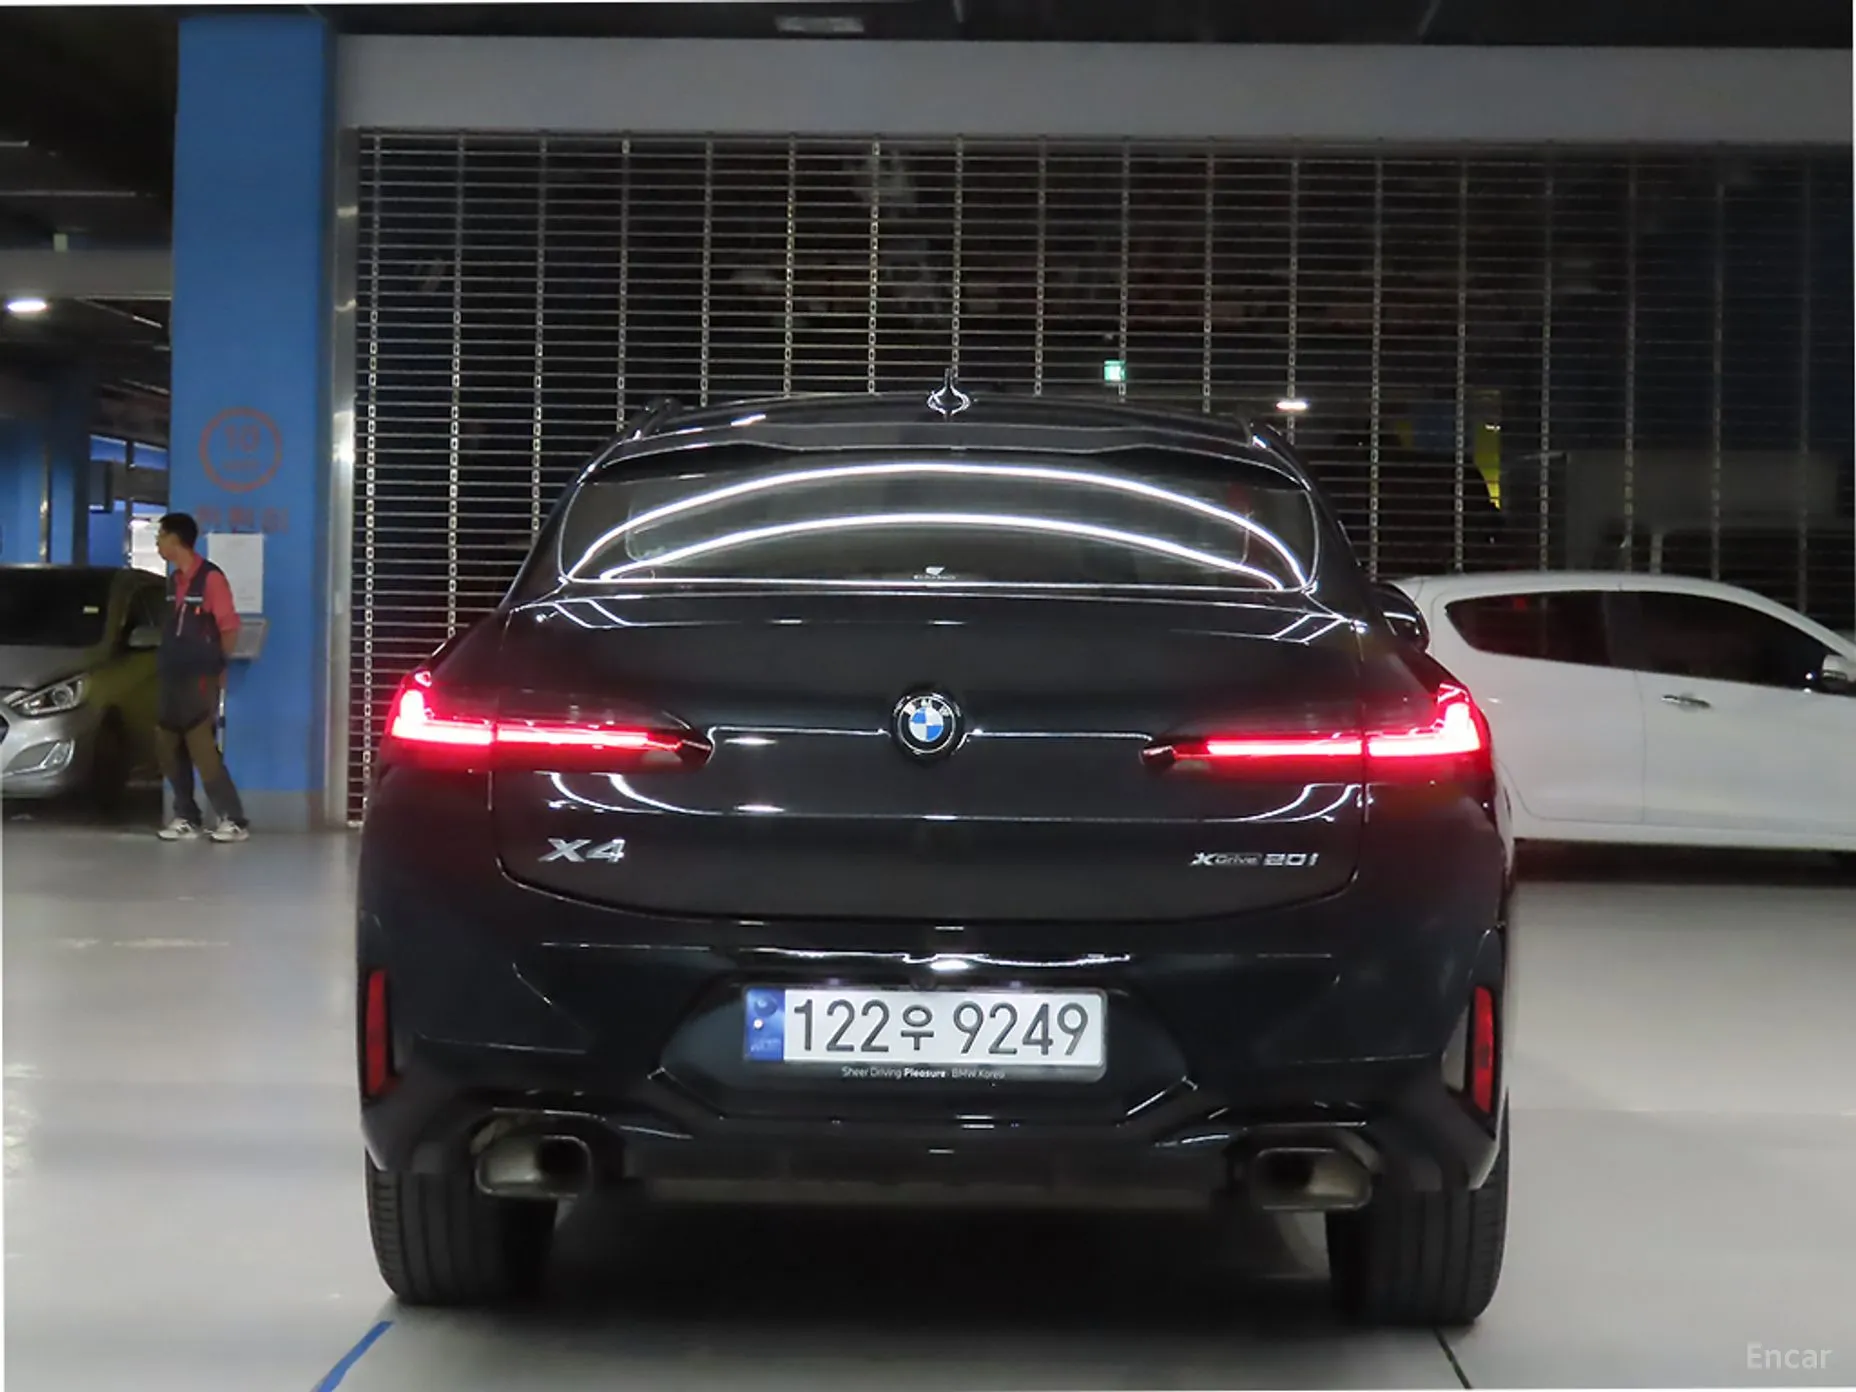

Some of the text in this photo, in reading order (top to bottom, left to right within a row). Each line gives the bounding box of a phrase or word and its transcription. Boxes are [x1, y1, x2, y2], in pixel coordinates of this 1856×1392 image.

[538, 838, 626, 862] X4
[793, 998, 1089, 1056] 122우 9249
[841, 1066, 869, 1078] Sheer
[870, 1066, 901, 1080] Driving
[903, 1067, 946, 1079] Pleasure
[951, 1067, 976, 1078] BMW
